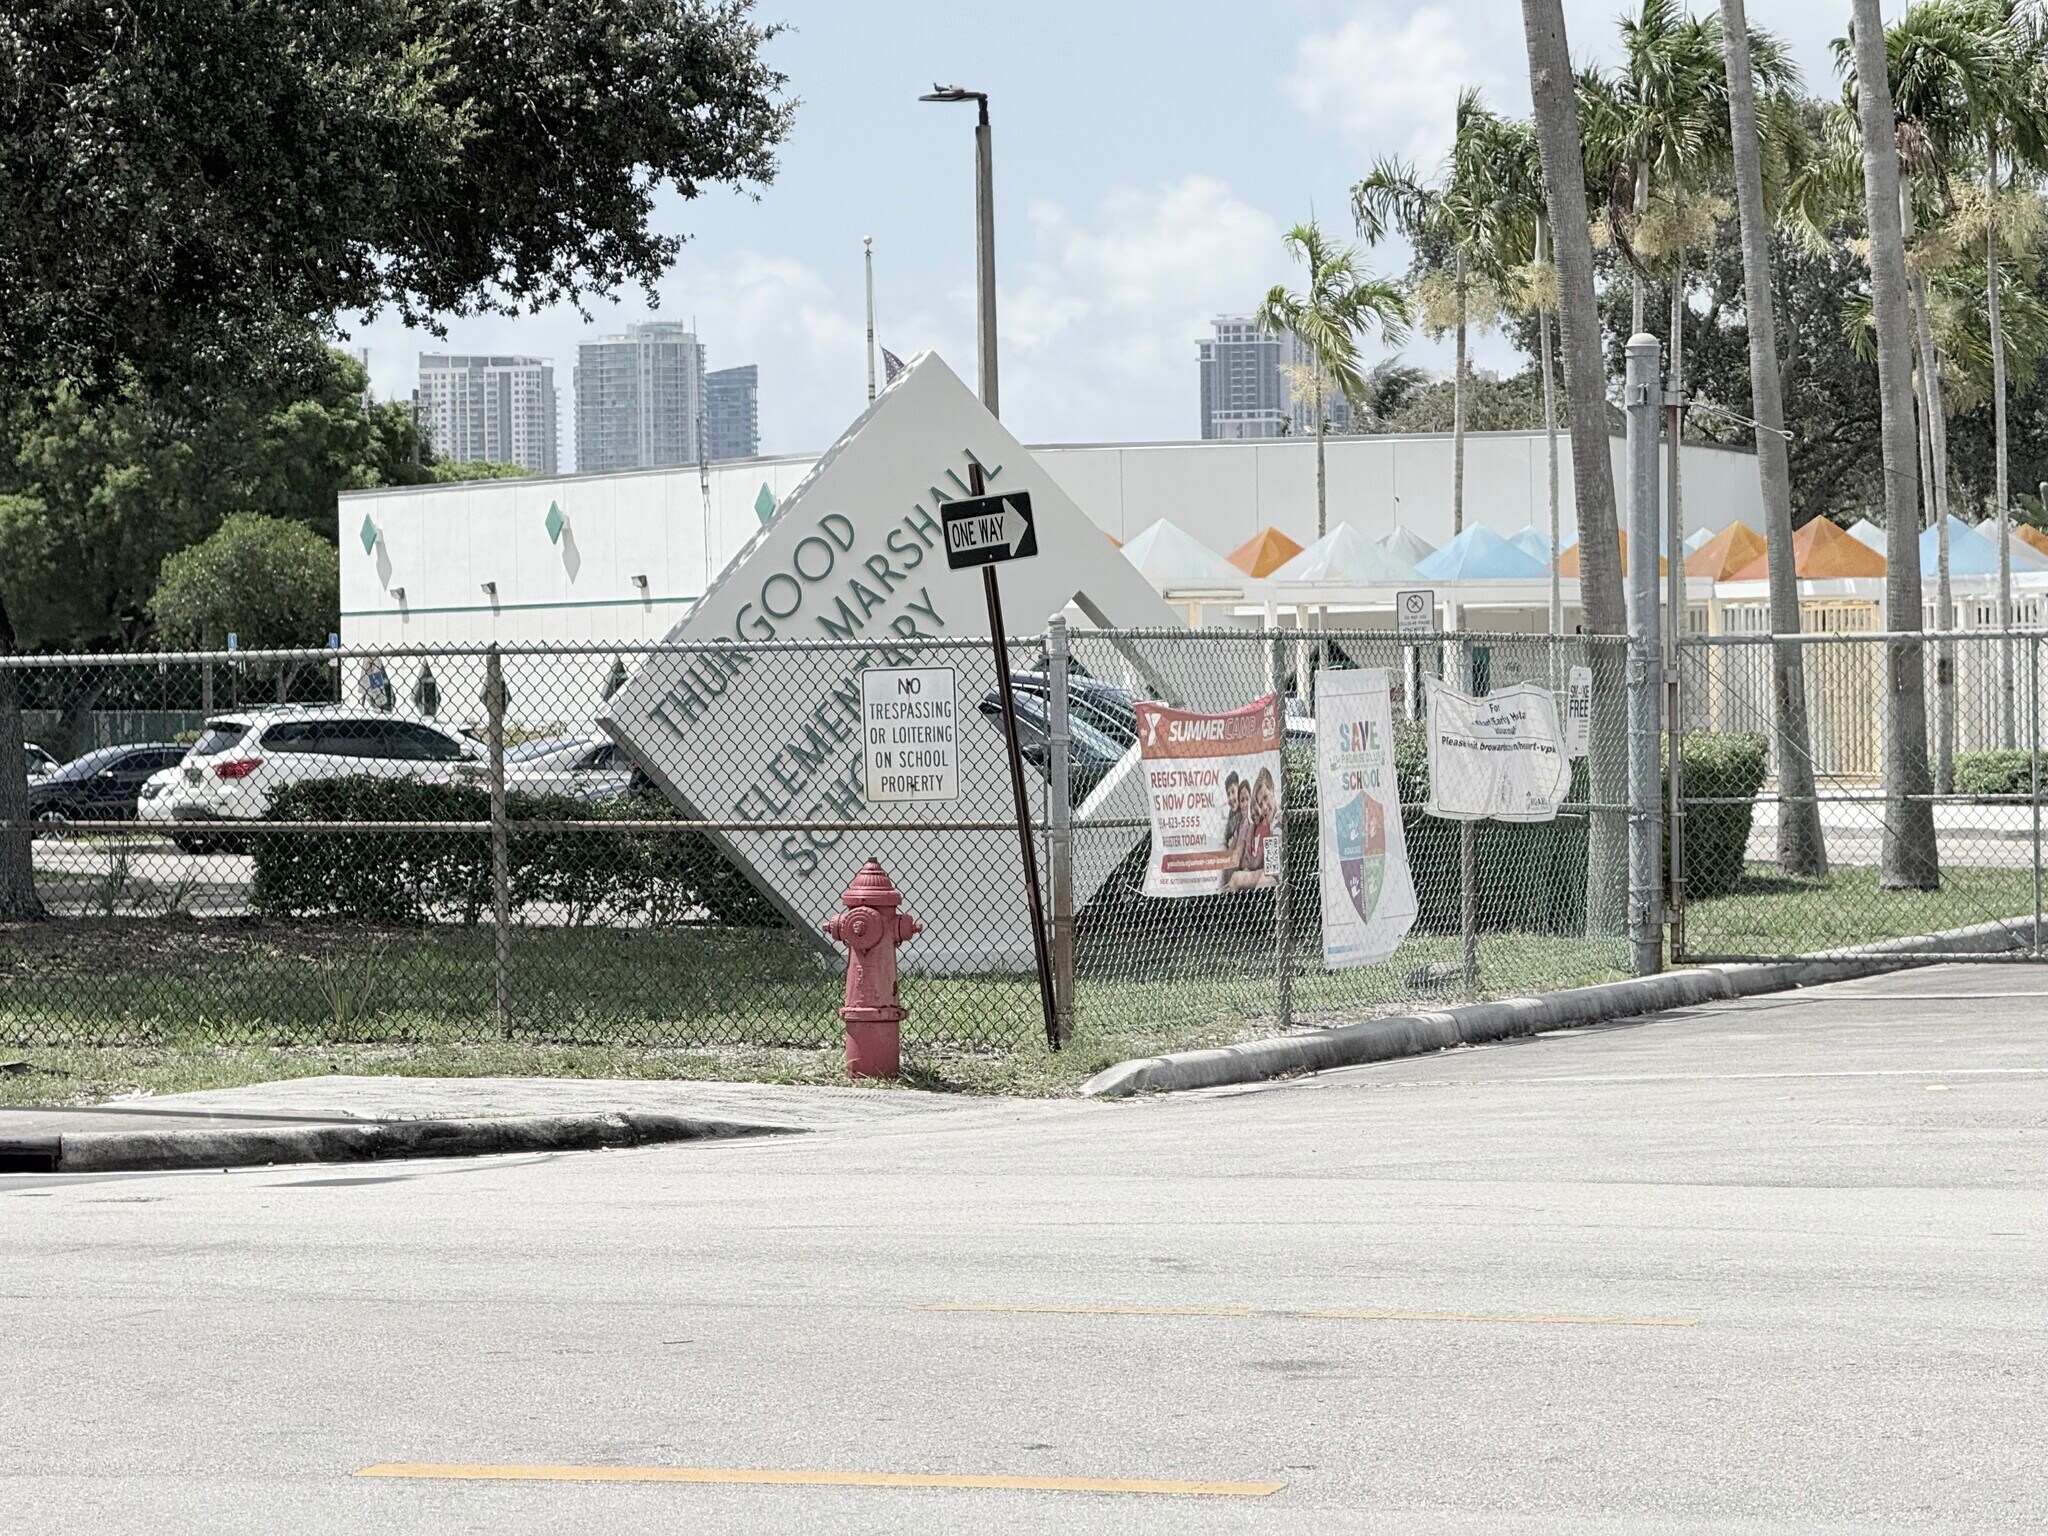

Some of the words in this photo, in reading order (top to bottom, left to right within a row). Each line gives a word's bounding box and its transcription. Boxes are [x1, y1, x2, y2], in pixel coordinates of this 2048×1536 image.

[952, 520, 977, 548] ONE
[978, 515, 1004, 544] WAY
[647, 513, 855, 739] THURGOOD
[898, 677, 921, 695] NO
[869, 700, 952, 720] TRESPASSING
[1569, 699, 1589, 718] FREE
[870, 727, 886, 744] OR
[892, 725, 952, 744] LOITERING
[1167, 718, 1225, 742] SUMMER
[1225, 715, 1256, 740] CAMP
[1339, 721, 1380, 753] SAVE
[875, 751, 892, 768] ON
[899, 749, 949, 768] SCHOOL
[881, 774, 943, 793] PROPERTY
[1150, 769, 1220, 789] REGISTRATION
[1341, 768, 1380, 791] SCHOOL
[1162, 793, 1185, 812] NOW
[1187, 792, 1216, 810] OPEN!
[1182, 834, 1207, 847] TODAY!
